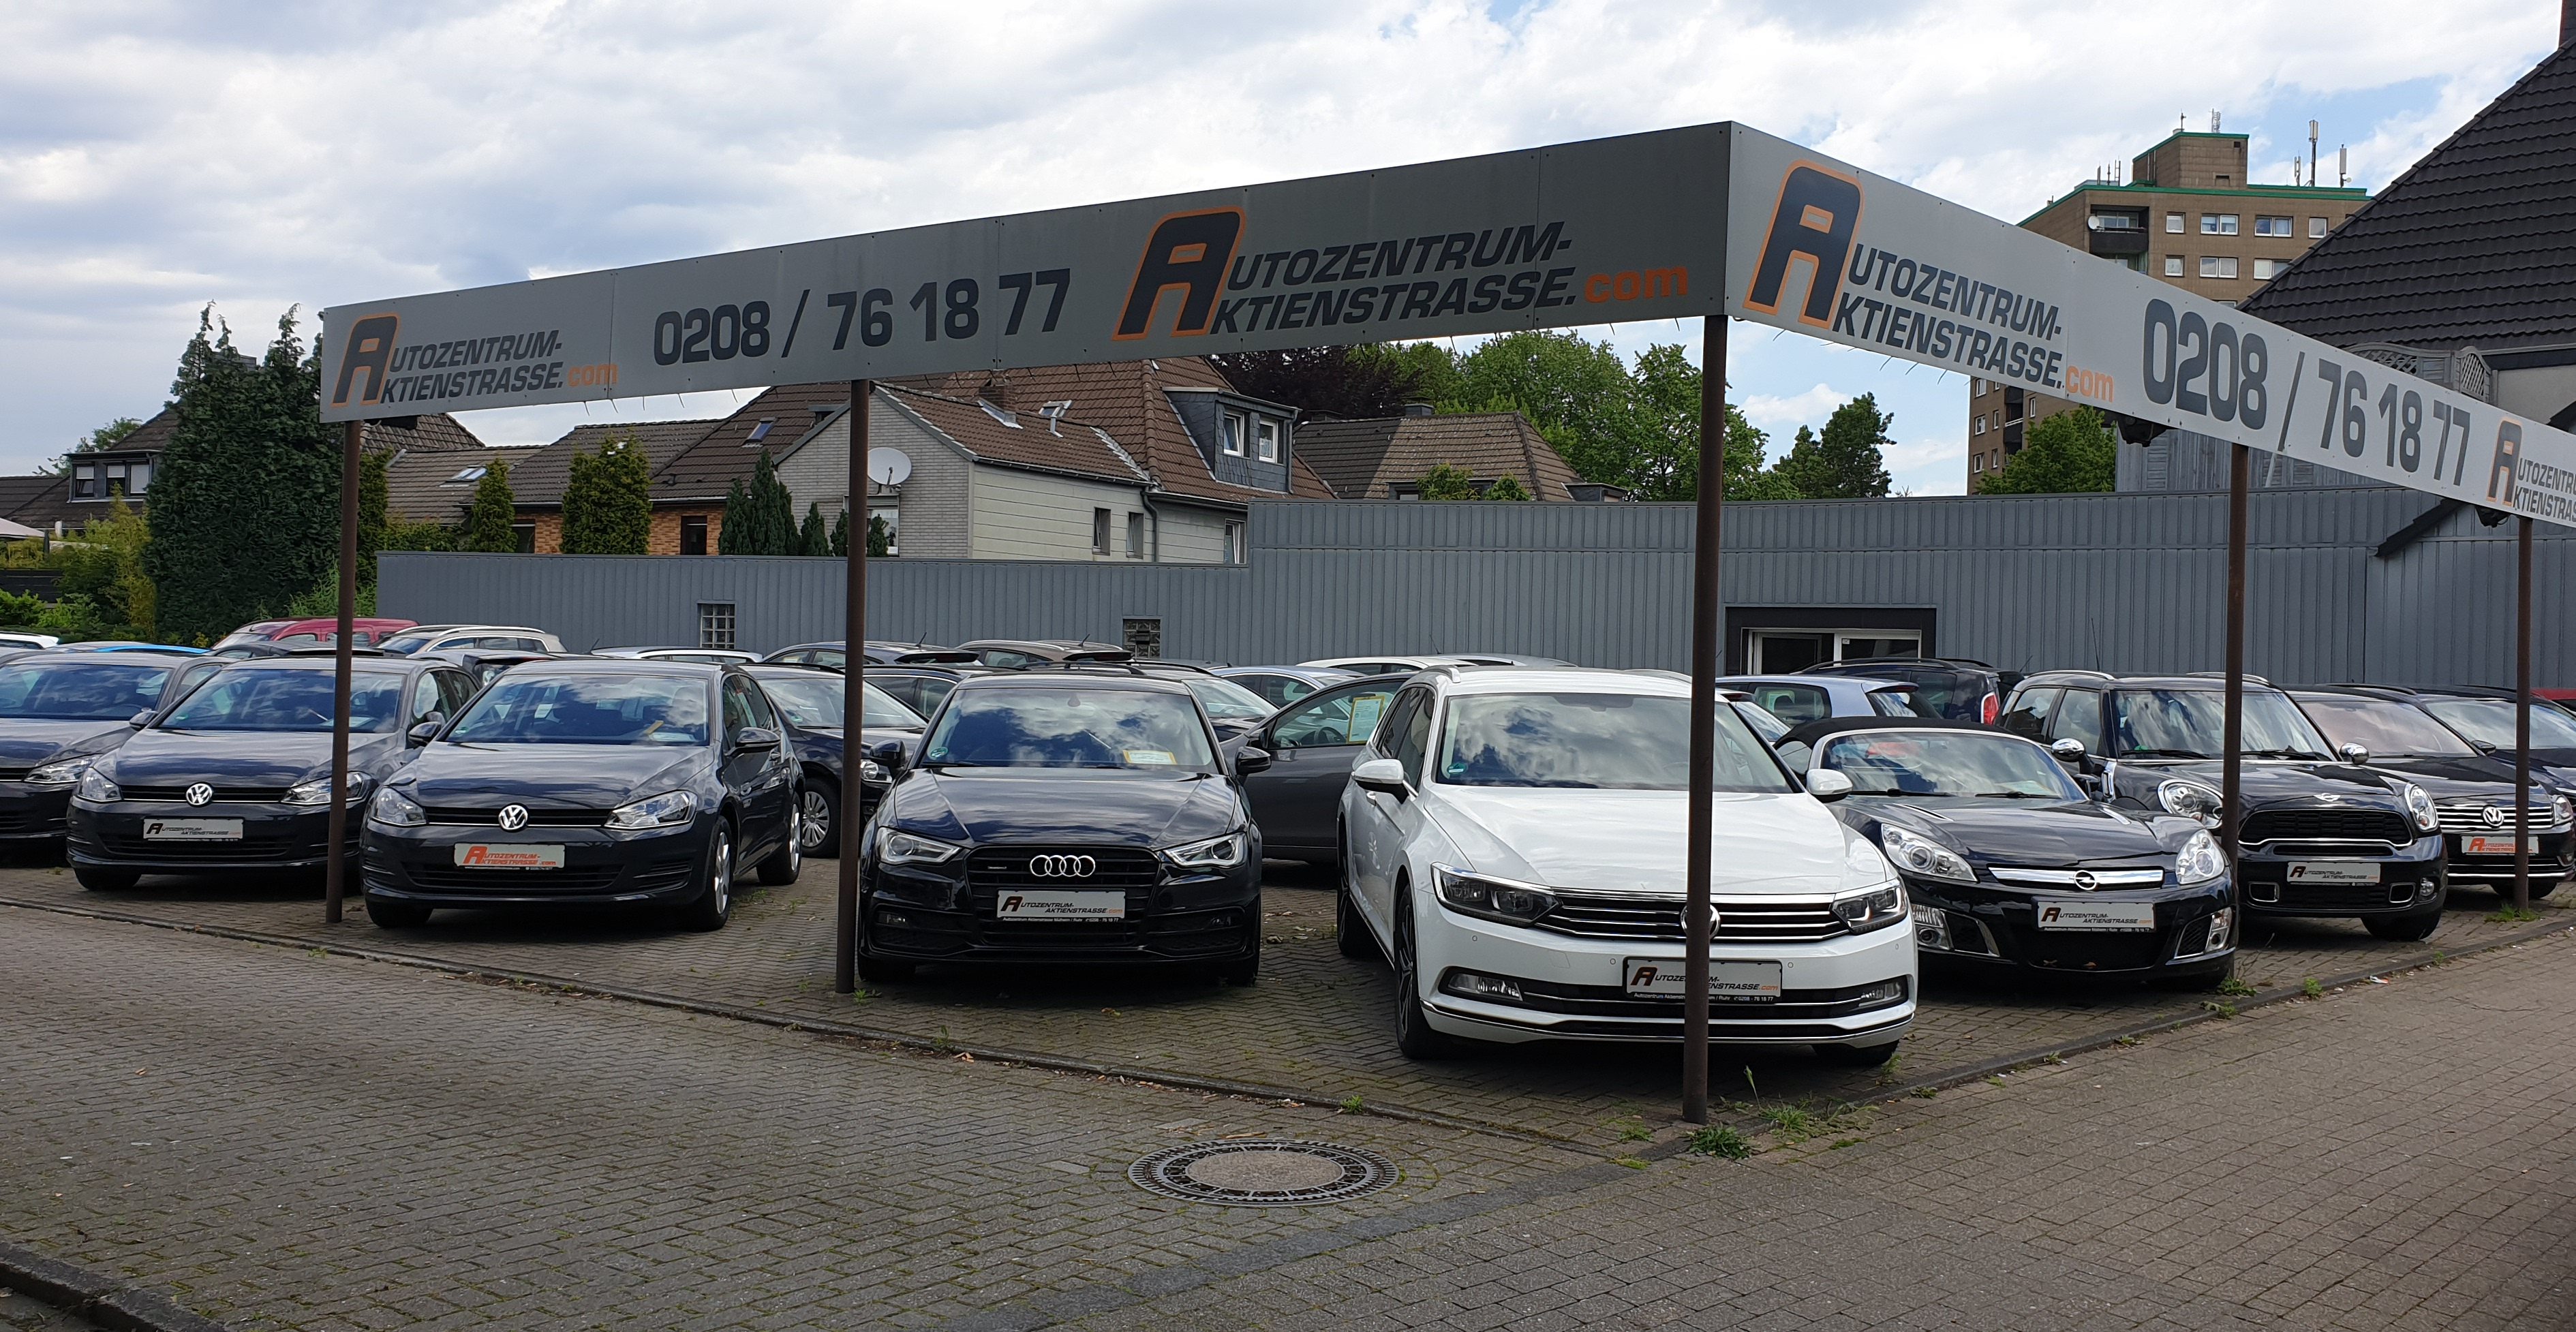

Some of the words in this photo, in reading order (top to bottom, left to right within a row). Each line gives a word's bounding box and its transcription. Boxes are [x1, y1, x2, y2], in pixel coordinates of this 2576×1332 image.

[654, 300, 770, 366] 0208
[782, 290, 808, 357] /
[827, 288, 893, 350] 76
[909, 278, 979, 341] 18
[998, 268, 1071, 336] 77
[2143, 298, 2268, 430] 0208
[2278, 351, 2305, 451] /
[2318, 358, 2367, 458] 76
[2378, 383, 2422, 473] 18
[2433, 399, 2471, 486] 77
[1000, 896, 1075, 912] AUTOZENTRUM-
